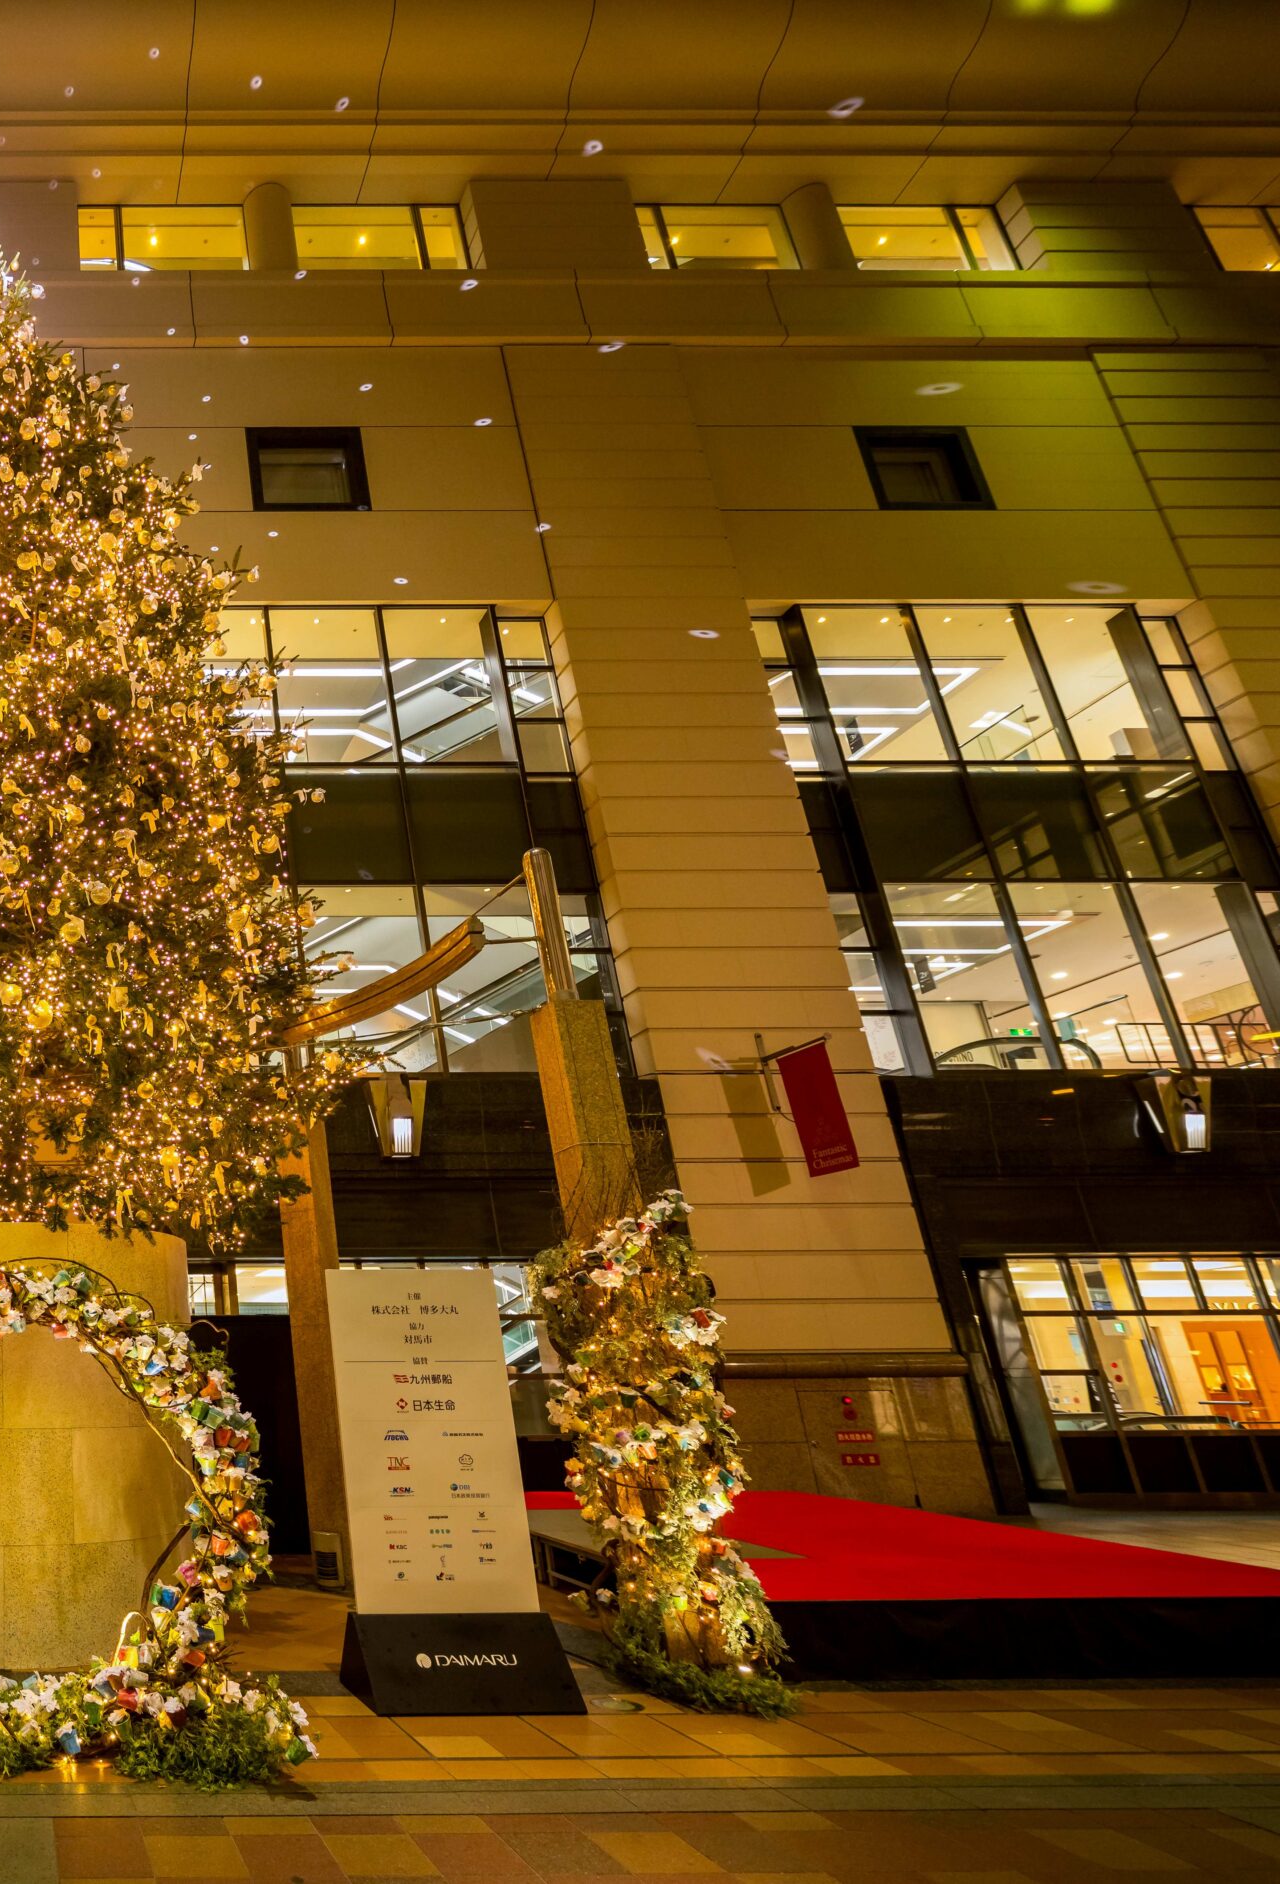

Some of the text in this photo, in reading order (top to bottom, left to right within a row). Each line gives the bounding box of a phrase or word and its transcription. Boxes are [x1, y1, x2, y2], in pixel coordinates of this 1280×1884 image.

[812, 1144, 847, 1158] Fantastic
[407, 1292, 421, 1301] 主催
[371, 1305, 459, 1315] 株式会社 博多大丸
[409, 1322, 425, 1331] 協力
[404, 1334, 433, 1345] 対馬市
[409, 1373, 453, 1385] 九州郵船
[412, 1400, 456, 1411] 日本生命
[387, 1456, 411, 1467] TNC
[392, 1486, 411, 1494] KSN
[434, 1654, 518, 1667] DAIMARU
